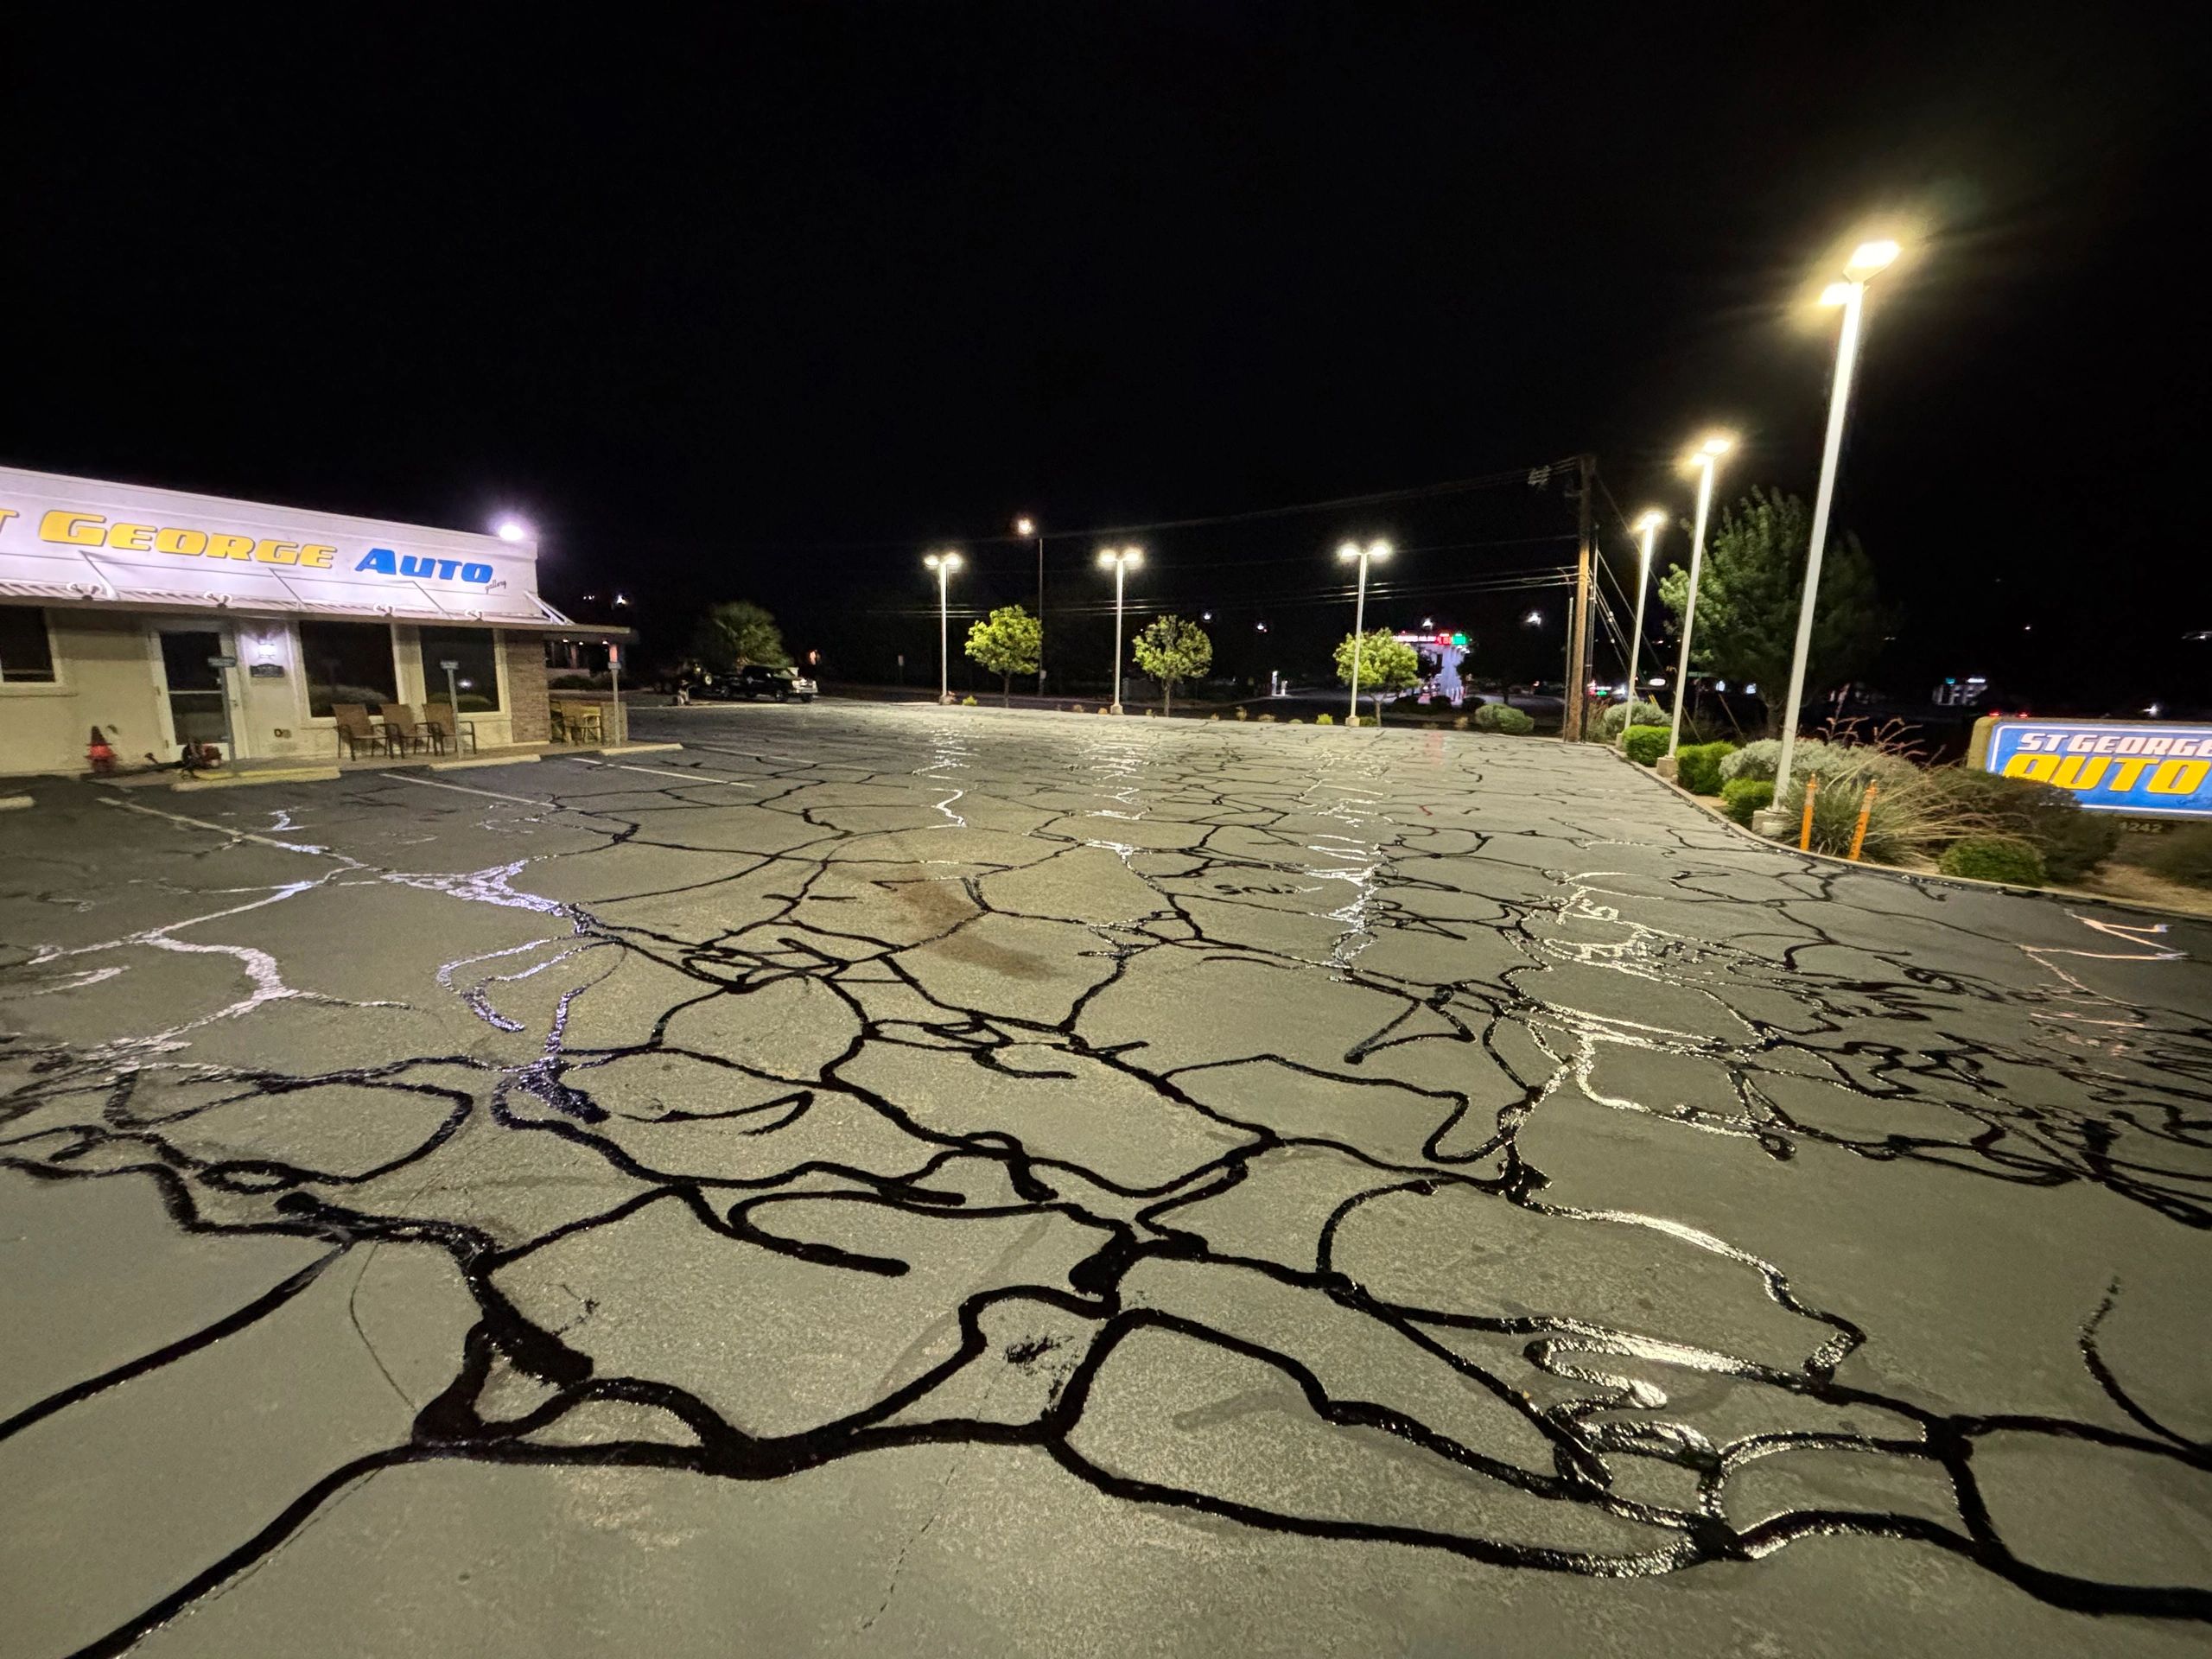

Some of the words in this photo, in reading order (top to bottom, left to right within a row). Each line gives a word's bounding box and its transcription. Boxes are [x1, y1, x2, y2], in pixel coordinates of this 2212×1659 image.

[39, 510, 338, 569] GEORGE
[354, 548, 493, 583] AUTO
[2002, 753, 2211, 795] AUTO
